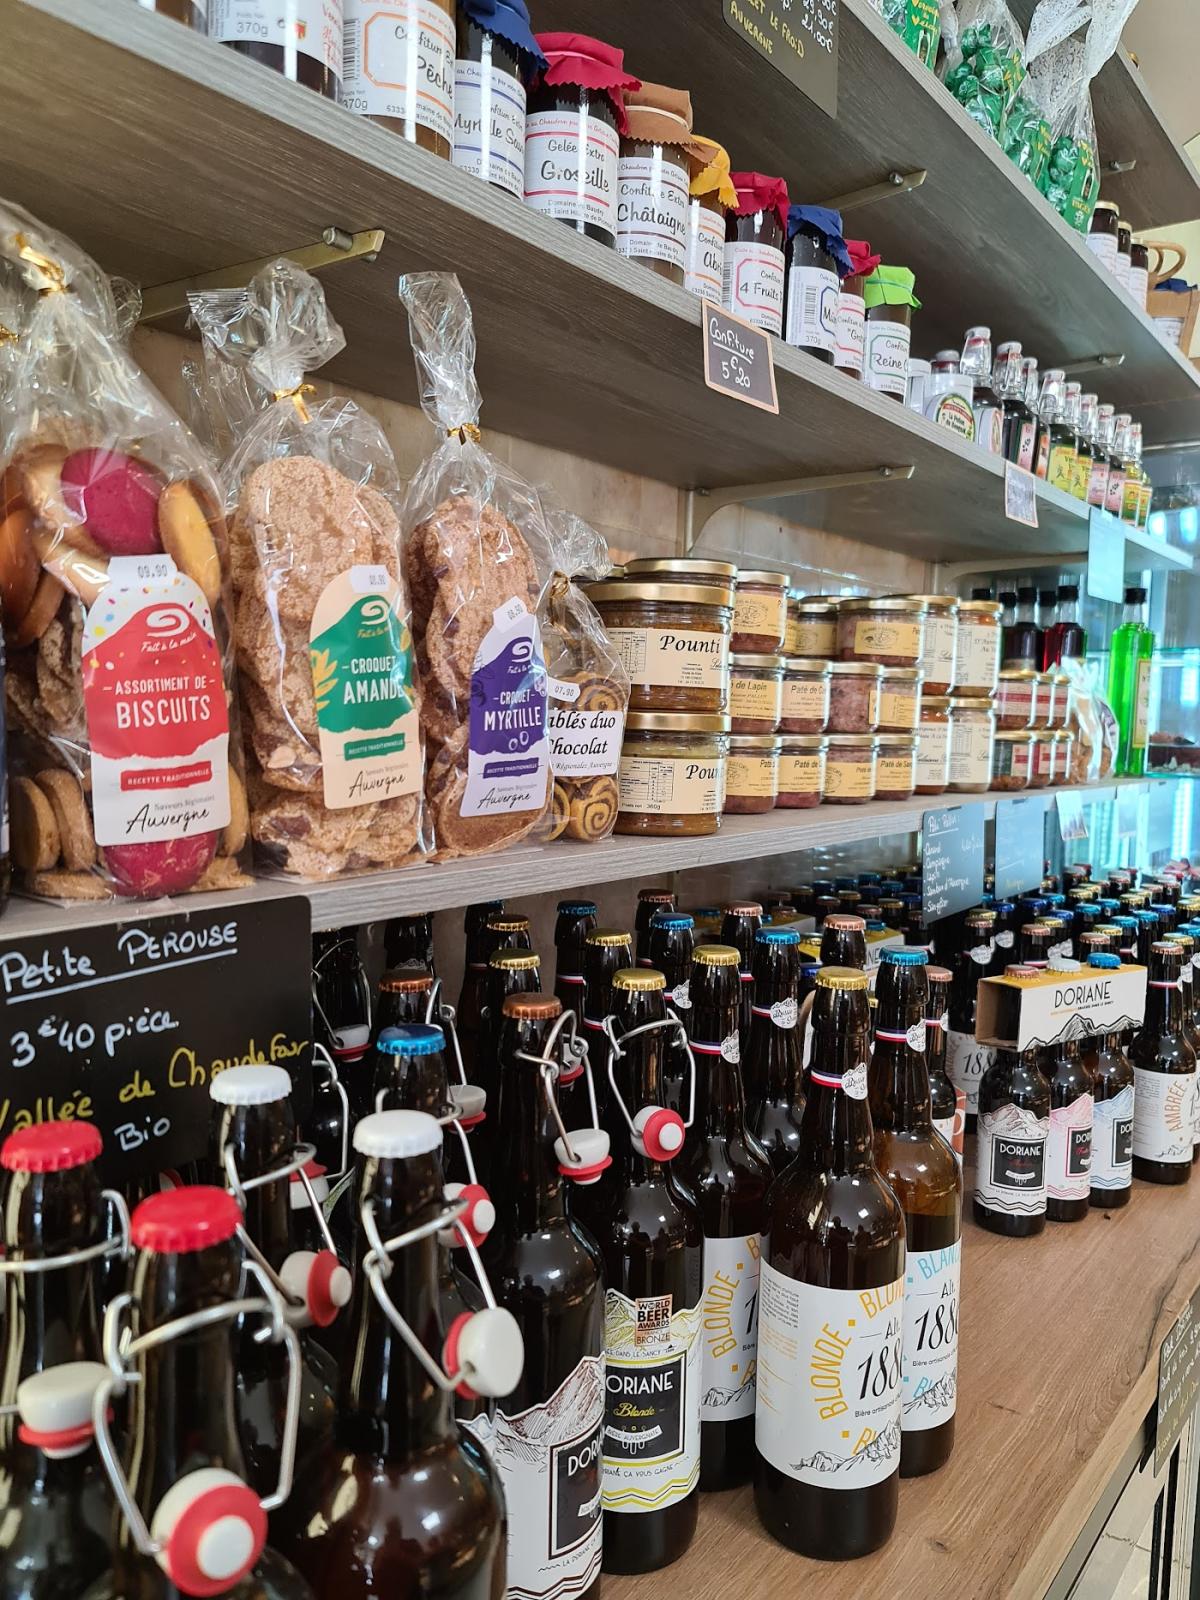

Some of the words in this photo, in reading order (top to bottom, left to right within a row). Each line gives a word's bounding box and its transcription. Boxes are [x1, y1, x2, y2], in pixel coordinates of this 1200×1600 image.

[236, 22, 268, 37] 370g
[730, 0, 773, 54] AUVERGNE
[547, 139, 578, 153] Gelée
[617, 200, 686, 236] Châtaigne
[740, 282, 749, 294] 4
[753, 282, 779, 302] Fruits
[137, 564, 168, 578] 09.90
[659, 635, 720, 654] Pounti
[114, 675, 190, 694] ASSORTIMENT
[194, 673, 207, 689] DE
[554, 685, 575, 697] 07.90
[747, 679, 767, 692] Lapin
[116, 694, 211, 730] BISCUITS
[483, 705, 542, 732] MYRTILLE
[590, 711, 617, 729] duo
[127, 775, 160, 785] RECETTE
[348, 770, 406, 798] Auvergne
[477, 787, 531, 809] Auvergne
[125, 803, 210, 834] Auvergne
[0, 946, 96, 992] Petite
[118, 921, 238, 964] PEROUSE
[1054, 980, 1112, 1008] DORIANE
[118, 1070, 155, 1103] de
[1164, 1080, 1187, 1132] AMBRÉE
[114, 1116, 171, 1152] Bio
[1000, 1143, 1042, 1157] DORIANE
[639, 1300, 671, 1311] WORLD
[703, 1270, 741, 1359] BLONDE
[637, 1309, 670, 1323] BEER
[638, 1320, 670, 1330] AWARDS
[636, 1332, 670, 1345] BRONZE
[810, 1323, 853, 1420] BLONDE
[912, 1359, 923, 1368] Bière
[613, 1402, 656, 1418] Blonde
[854, 1408, 871, 1418] Bière
